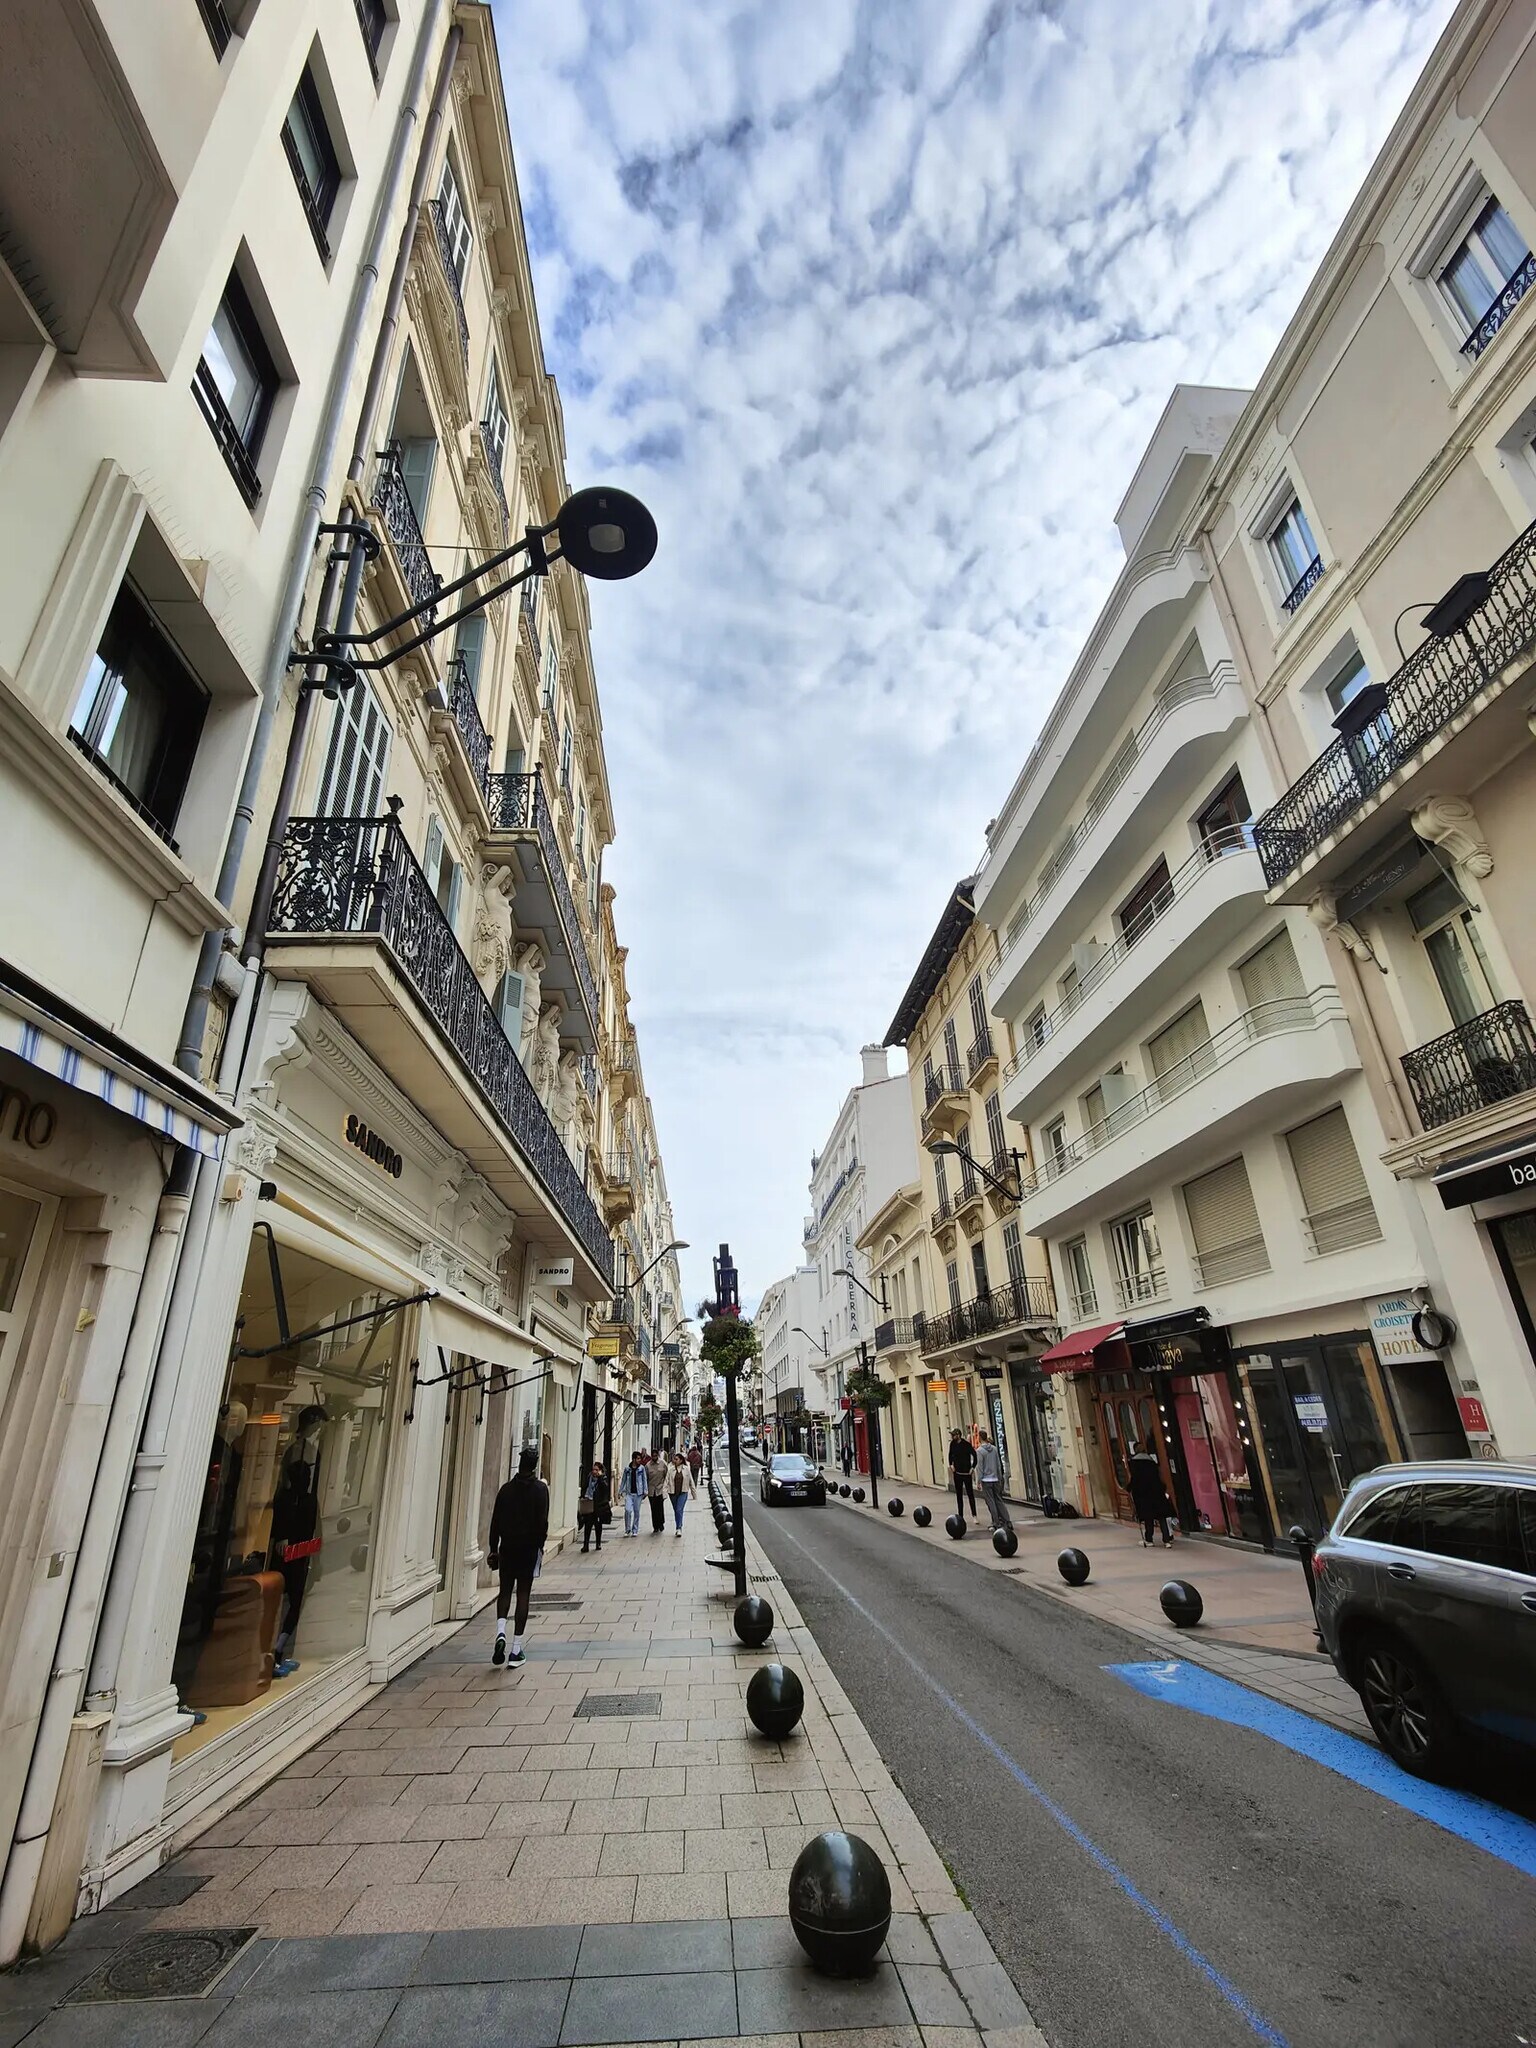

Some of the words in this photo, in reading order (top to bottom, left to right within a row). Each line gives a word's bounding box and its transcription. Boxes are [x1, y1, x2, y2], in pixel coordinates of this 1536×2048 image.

[346, 1114, 402, 1178] SANDRO
[1508, 1163, 1536, 1185] ba
[845, 1226, 851, 1245] LE
[1374, 1313, 1415, 1329] CROISETT
[1381, 1339, 1431, 1357] HOTE
[1469, 1404, 1481, 1416] H
